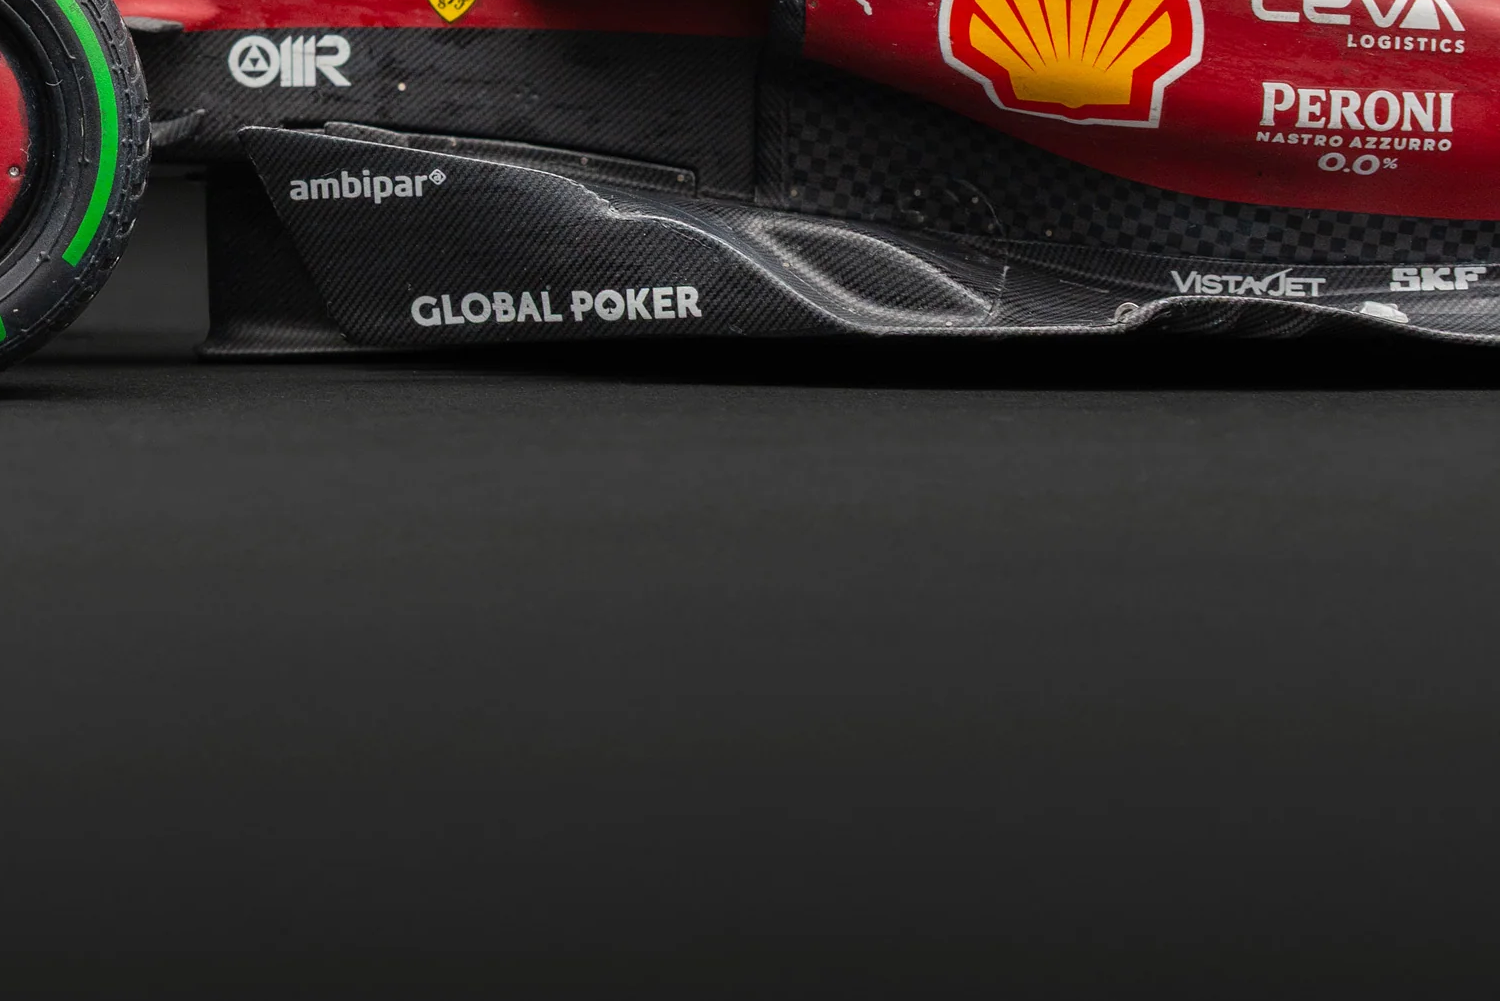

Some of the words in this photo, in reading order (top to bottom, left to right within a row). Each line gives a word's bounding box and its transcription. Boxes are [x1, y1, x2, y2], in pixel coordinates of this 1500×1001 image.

[1347, 33, 1467, 54] LOGISTICS
[1259, 81, 1454, 132] PERONI
[1256, 131, 1343, 148] NASTRO
[1349, 136, 1453, 152] AZZURRO
[289, 169, 428, 204] ambipar
[1390, 267, 1487, 292] SKF
[410, 292, 562, 326] GLOBAL
[569, 286, 702, 323] POKER
